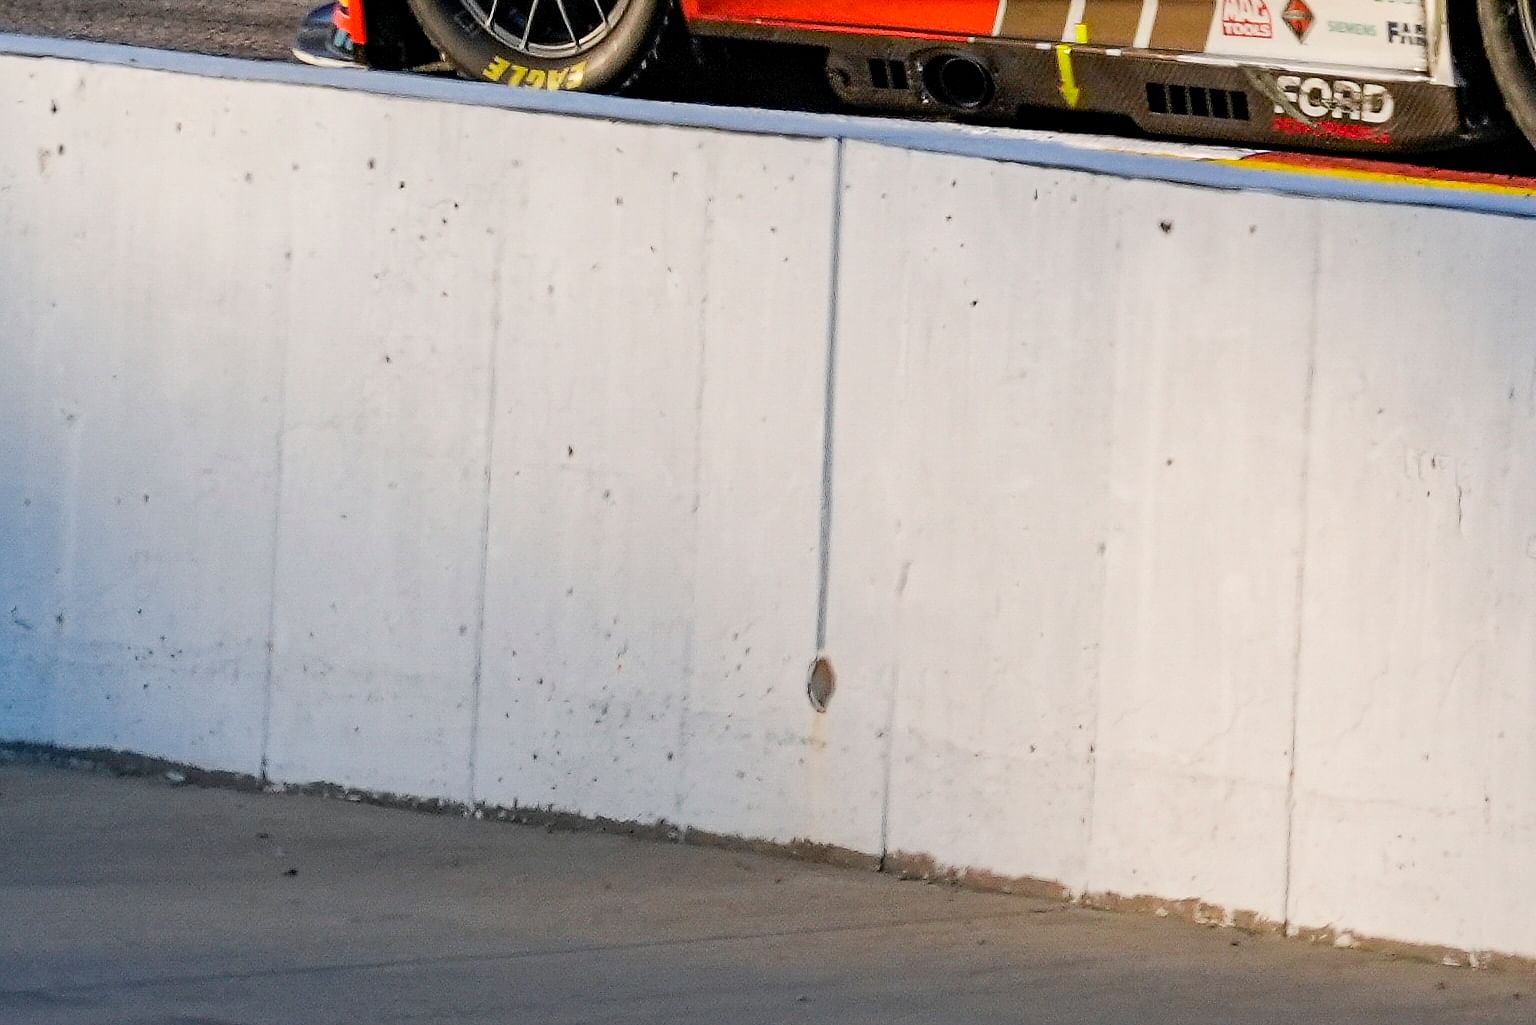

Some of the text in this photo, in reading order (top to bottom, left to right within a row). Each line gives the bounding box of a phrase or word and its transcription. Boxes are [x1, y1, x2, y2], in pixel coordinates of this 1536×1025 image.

[1223, 21, 1273, 39] TOOLS
[481, 55, 588, 92] EAGLE
[1273, 75, 1395, 124] FORD
